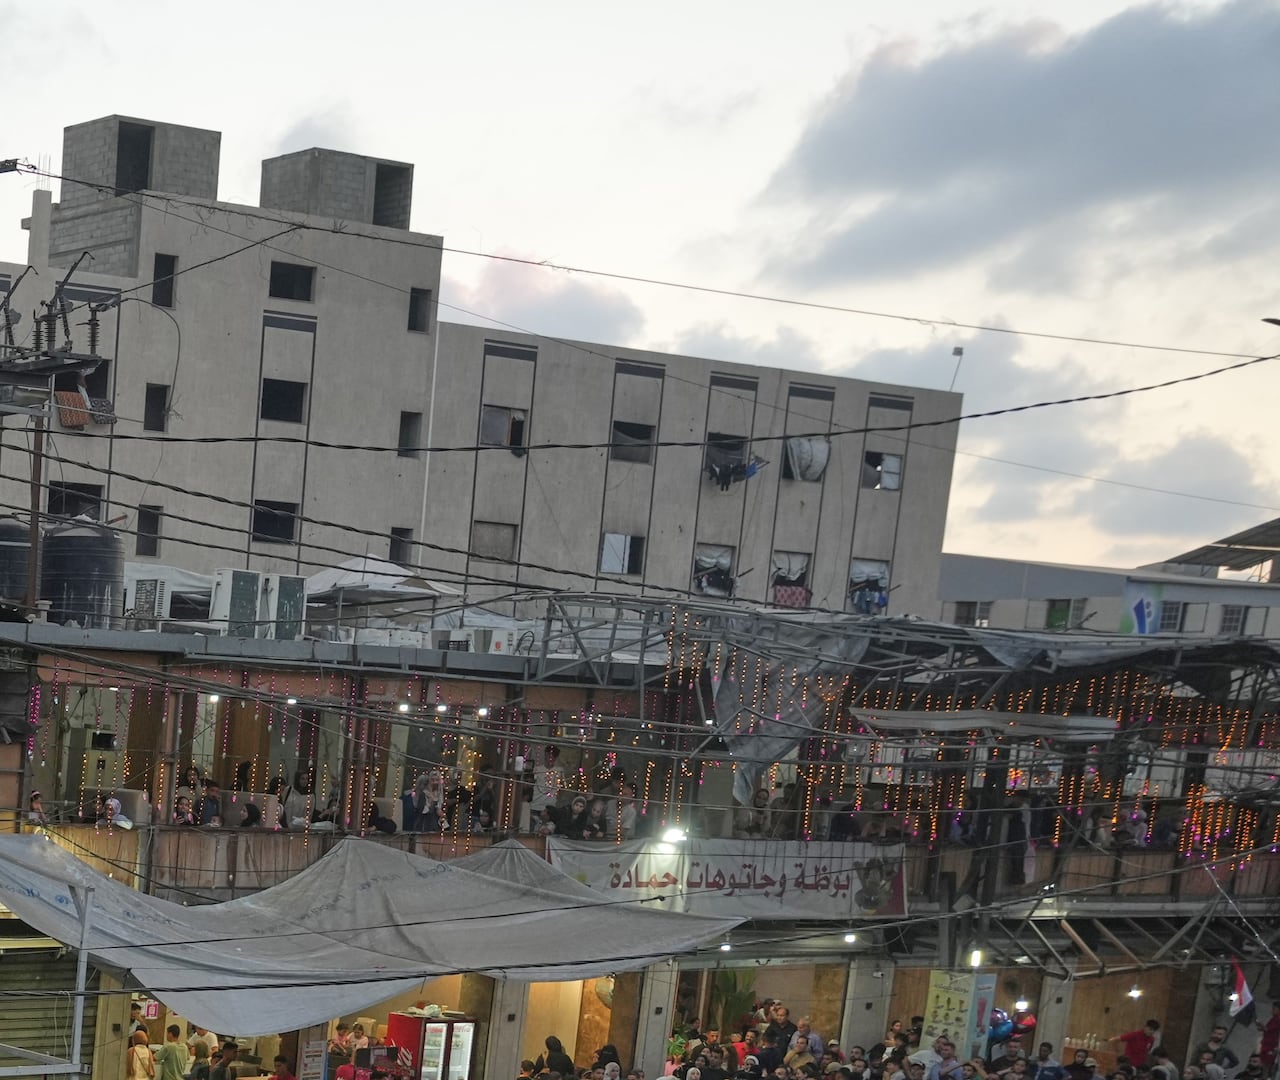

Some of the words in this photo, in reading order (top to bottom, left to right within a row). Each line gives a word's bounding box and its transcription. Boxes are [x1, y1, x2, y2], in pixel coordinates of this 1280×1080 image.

[608, 860, 679, 890] حمادة
[685, 860, 786, 898] وجاتوهات
[793, 860, 850, 898] بوظة
